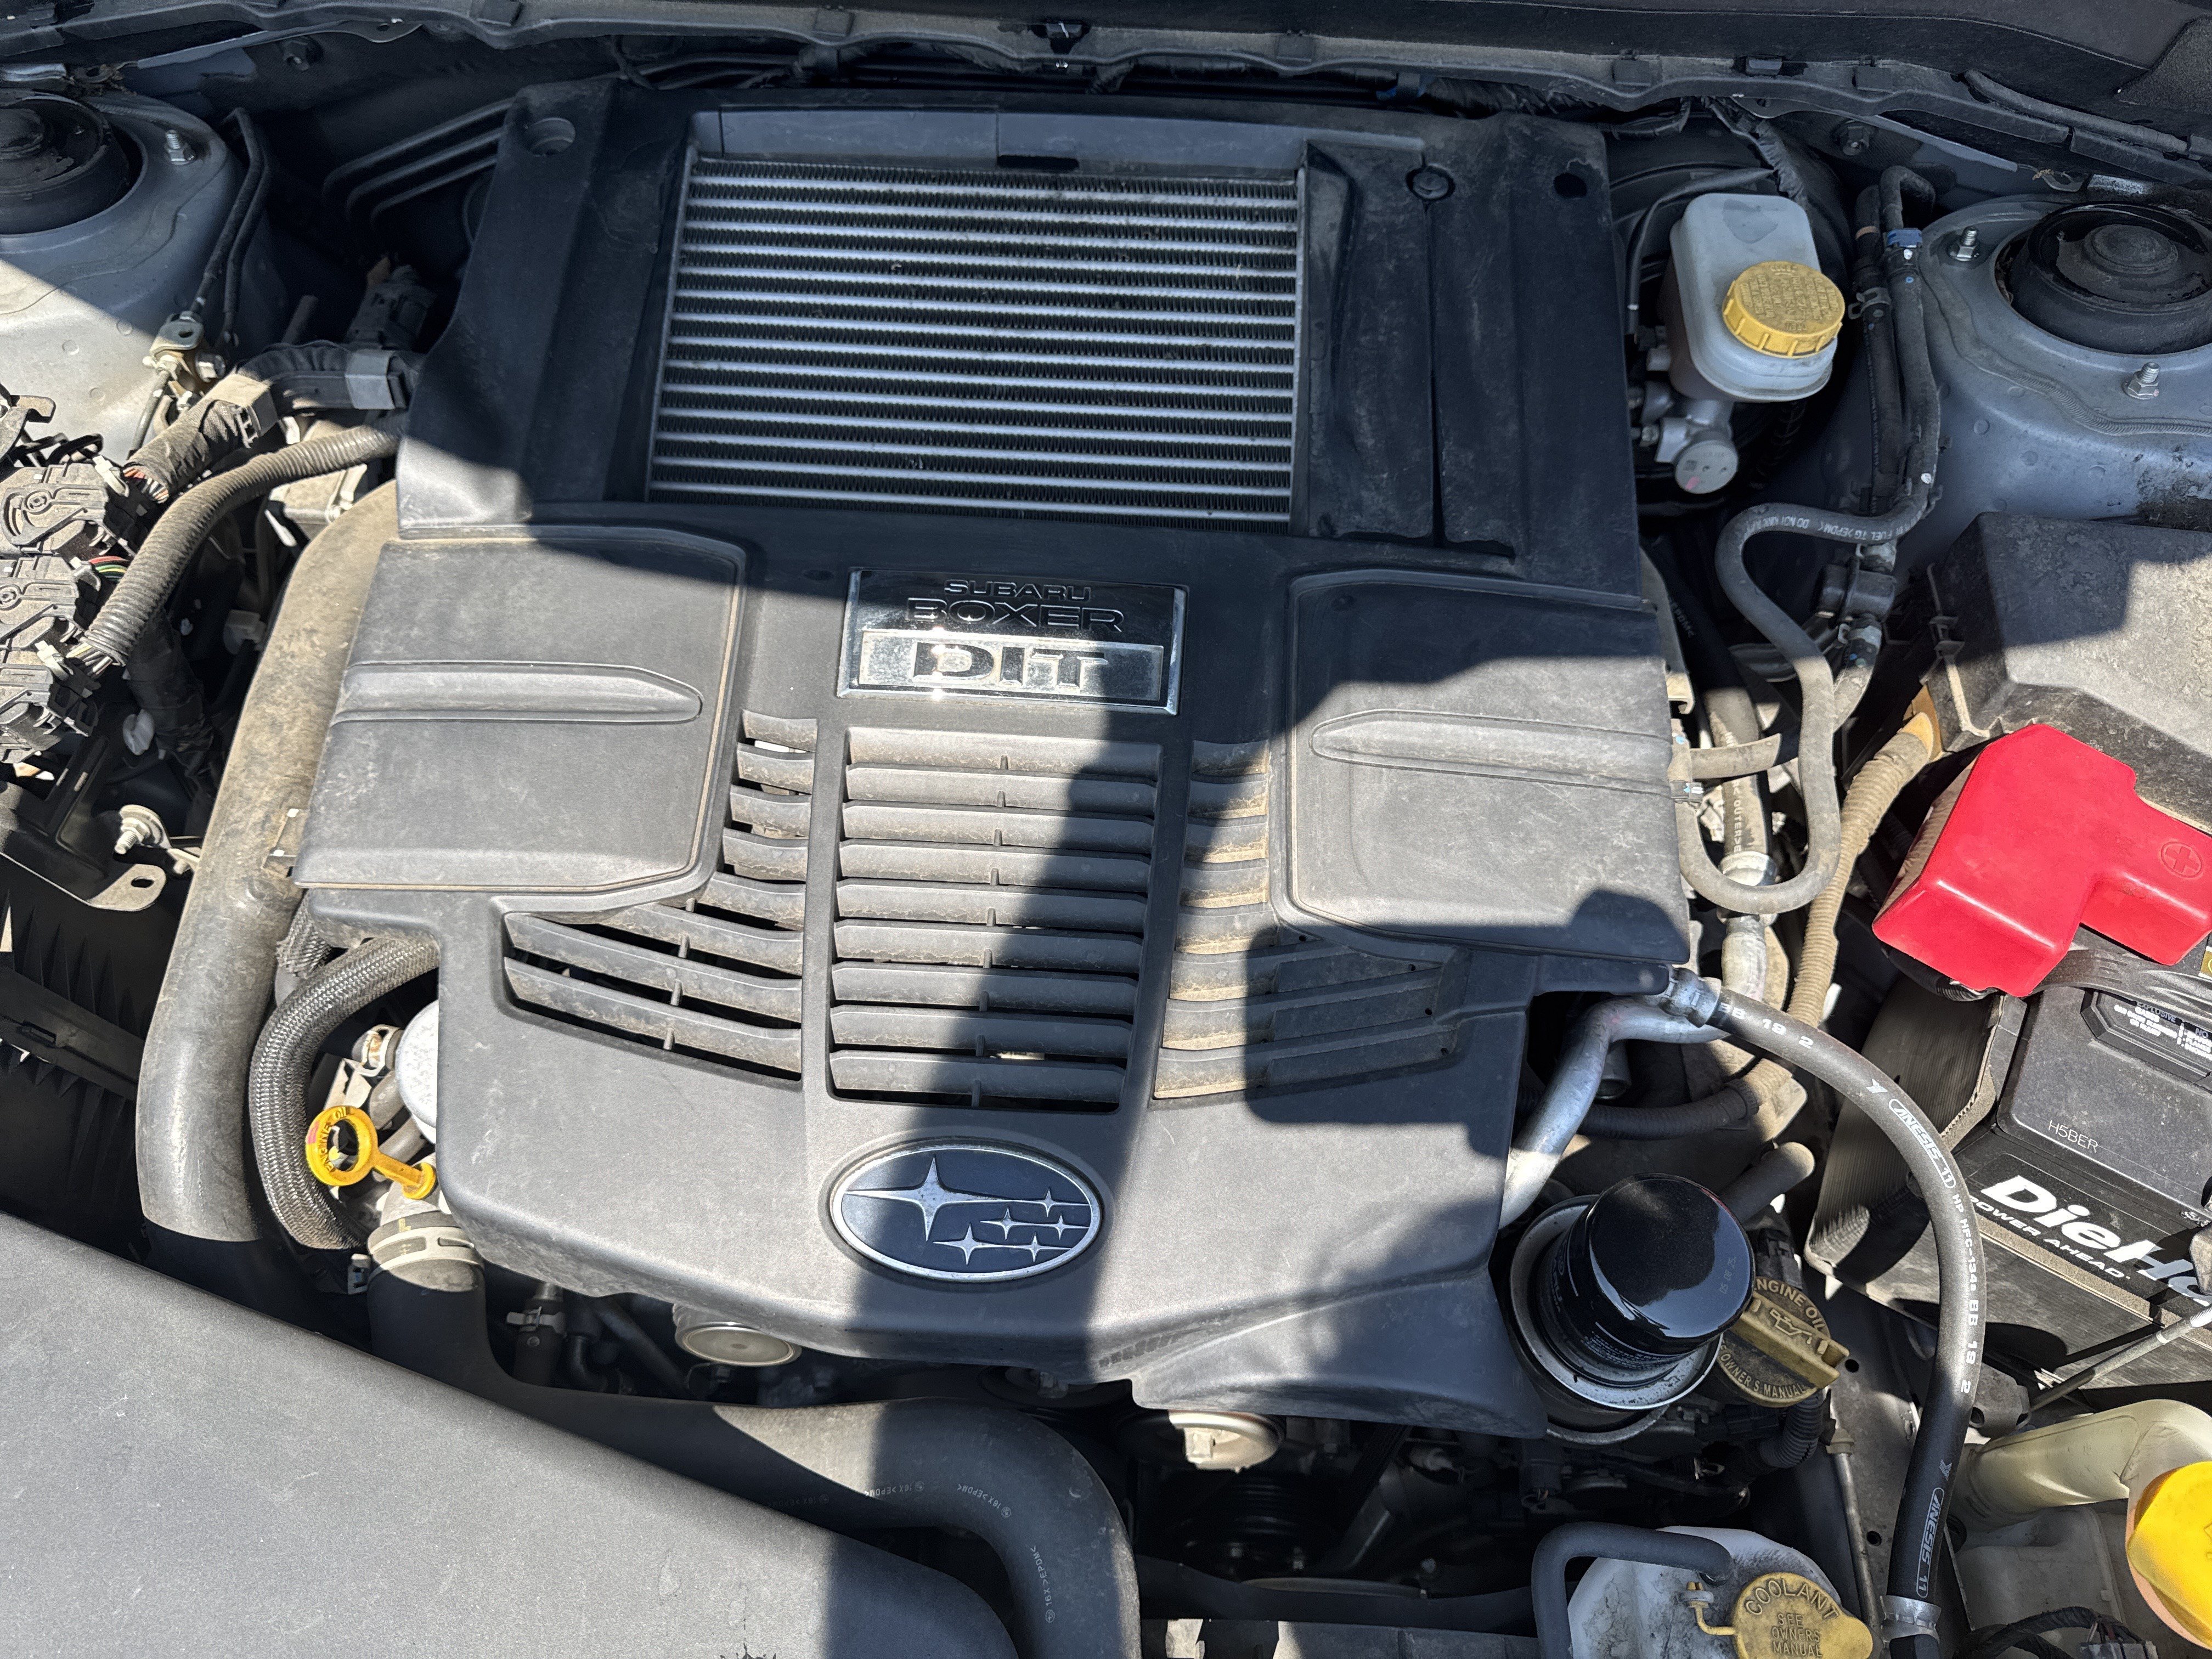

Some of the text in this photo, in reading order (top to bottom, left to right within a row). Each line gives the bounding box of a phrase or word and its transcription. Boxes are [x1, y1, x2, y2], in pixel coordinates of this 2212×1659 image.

[944, 579, 1091, 602] SUBARU
[908, 597, 1124, 633] BOXER
[913, 642, 1108, 691] DIT
[1762, 1018, 1786, 1035] 19
[2196, 1028, 2209, 1039] NO
[1798, 1035, 1814, 1049] 2
[318, 1107, 349, 1173] ENGINE OIL
[2048, 1119, 2099, 1153] H5BER
[1952, 1194, 1964, 1212] HP
[2043, 1239, 2125, 1278] AHEAD
[1754, 1278, 1826, 1333] NGINE OIL
[1968, 1300, 1979, 1327] BB
[1720, 1353, 1808, 1399] OWNERS MANUAL
[1960, 1379, 1971, 1394] 2
[1745, 1578, 1839, 1619] COOLANT
[1777, 1613, 1804, 1628] SEE
[1771, 1626, 1822, 1643] OWNERS
[1772, 1640, 1823, 1658] MANUAL
